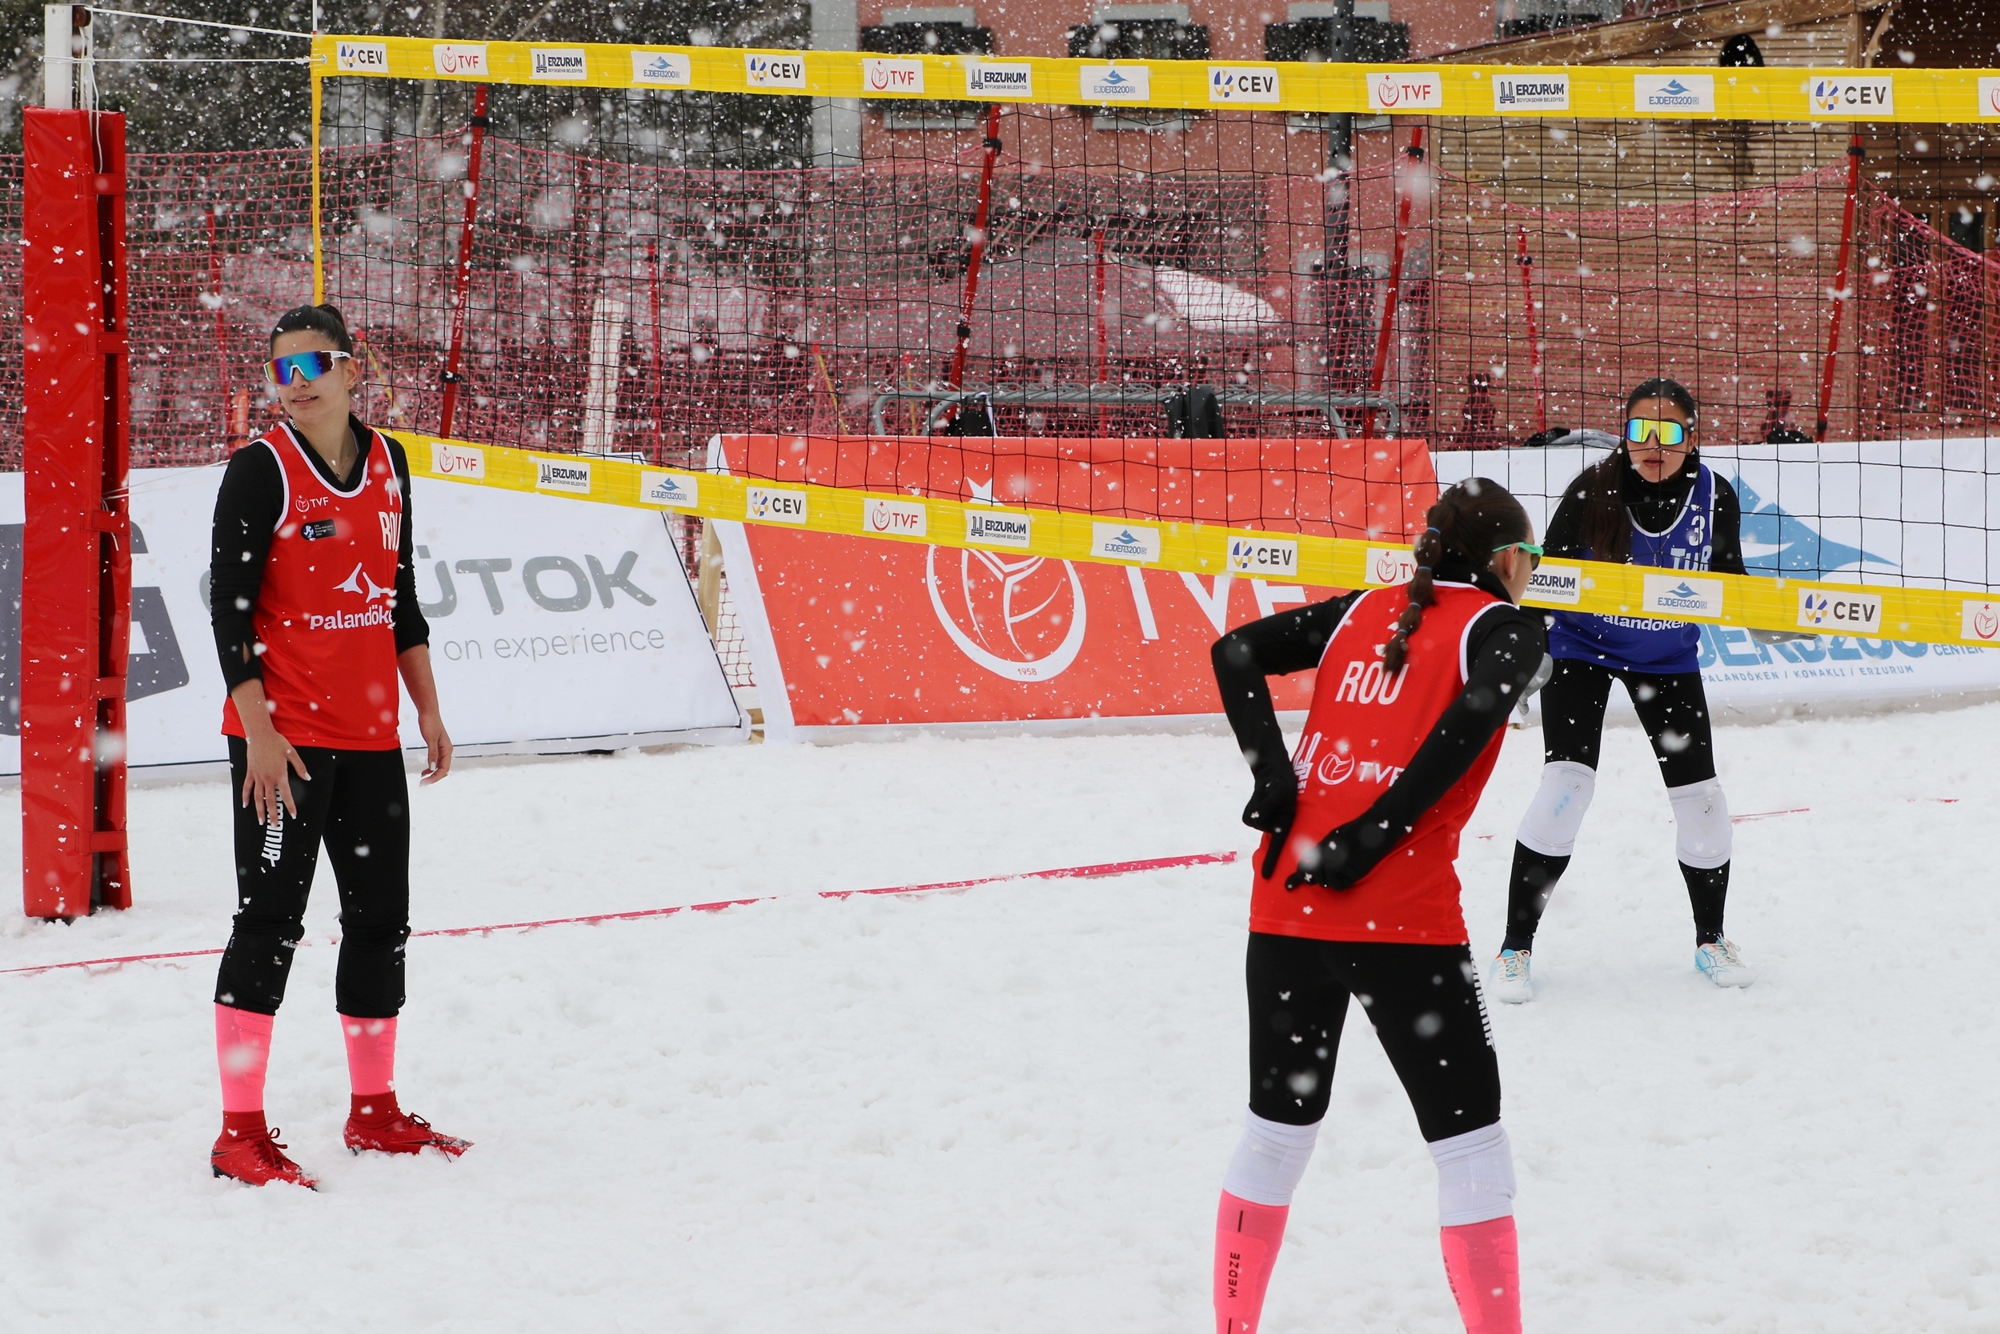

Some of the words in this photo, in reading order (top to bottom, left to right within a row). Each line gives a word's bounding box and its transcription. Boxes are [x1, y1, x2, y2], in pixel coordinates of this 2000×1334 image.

[358, 50, 383, 64] CEV
[458, 55, 479, 68] TVF
[548, 56, 582, 67] ERZURUM
[771, 62, 800, 79] CEV
[890, 70, 914, 85] TVF
[984, 72, 1026, 83] ERZURUM
[1238, 76, 1273, 93] CEV
[1516, 83, 1564, 95] ERZURUM
[1402, 85, 1431, 100] TVF
[1844, 86, 1886, 105] CEV
[1649, 96, 1692, 105] EJDER3200
[456, 456, 477, 471] TVF
[552, 467, 587, 481] ERZURUM
[310, 496, 329, 508] TVF
[772, 498, 802, 514] CEV
[893, 513, 919, 529] TVF
[985, 519, 1027, 534] ERZURUM
[1688, 515, 1705, 546] 3
[1257, 547, 1292, 565] CEV
[1400, 563, 1418, 579] TV
[1658, 597, 1700, 609] EJDER3200
[310, 605, 393, 630] Palandök
[1833, 602, 1875, 622] CEV
[444, 640, 482, 661] on
[494, 628, 665, 662] experience
[1017, 667, 1038, 677] 1958
[1793, 668, 1845, 679] KONAKLI
[1859, 665, 1914, 676] ERZURUM
[1335, 661, 1409, 705] ROU
[1228, 1252, 1240, 1298] WEDZE
